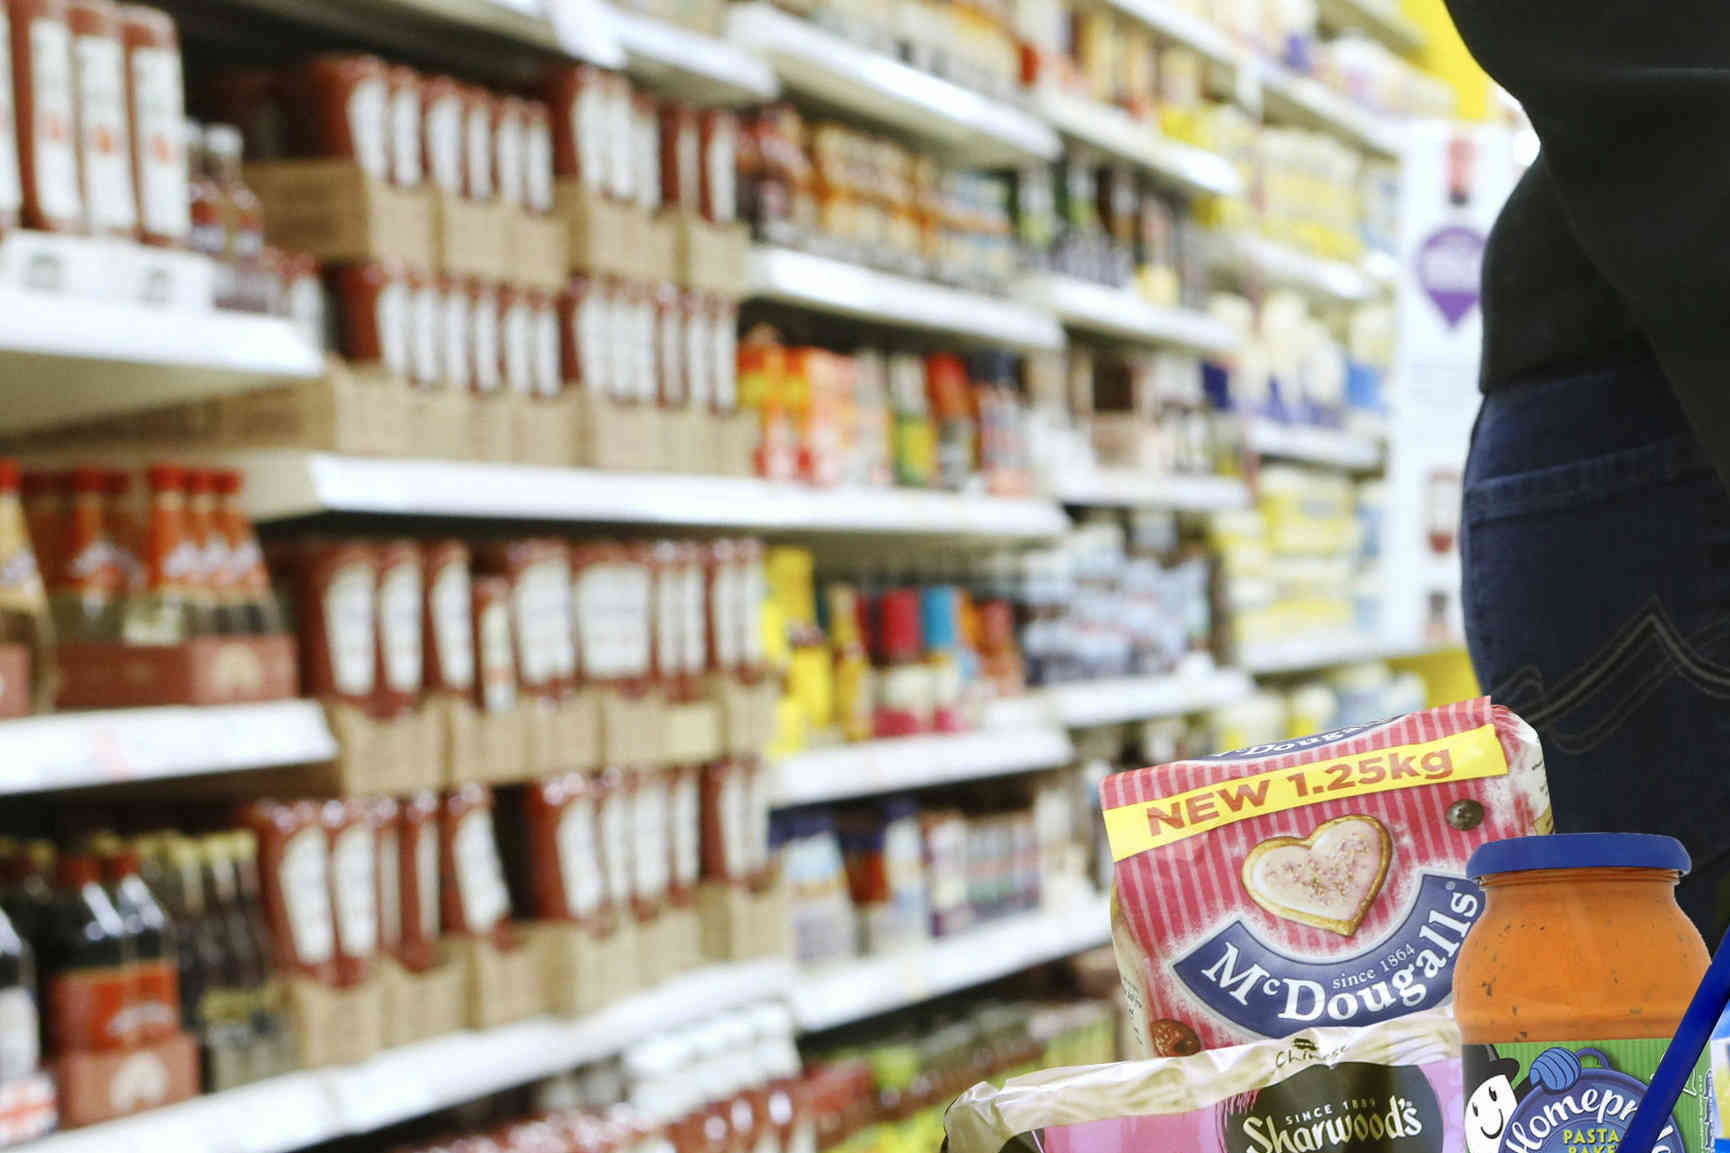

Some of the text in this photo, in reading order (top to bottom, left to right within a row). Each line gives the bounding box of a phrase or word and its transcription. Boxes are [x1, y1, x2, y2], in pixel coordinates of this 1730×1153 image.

[1147, 747, 1454, 837] NEW 1.25kg
[1202, 889, 1479, 1023] McDougalls
[1332, 943, 1417, 990] since 1864
[1284, 1104, 1335, 1126] SINCE
[1562, 1127, 1620, 1146] PASTA
